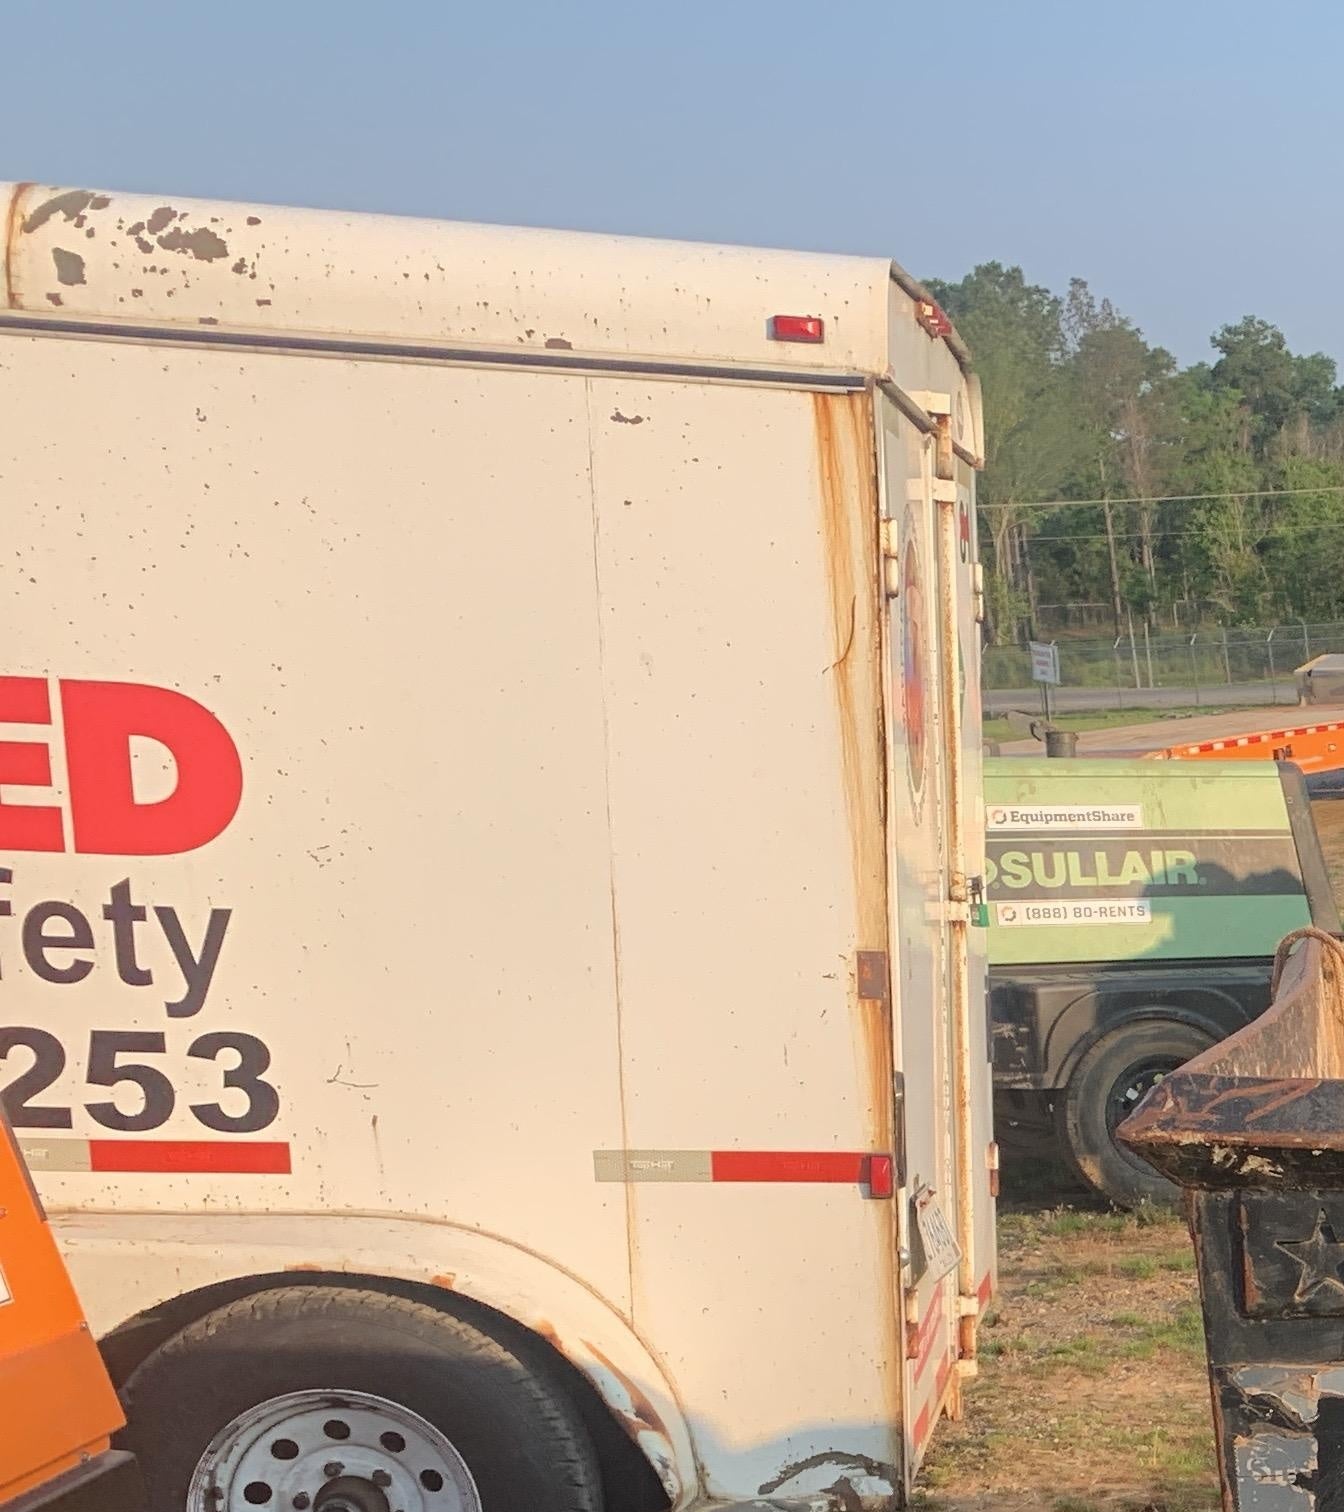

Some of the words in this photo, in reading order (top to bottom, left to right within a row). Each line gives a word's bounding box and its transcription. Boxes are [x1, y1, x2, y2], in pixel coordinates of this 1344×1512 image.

[1010, 810, 1135, 824] EquipmentShare
[1025, 906, 1068, 920] (888)
[1073, 904, 1146, 919] 80-RENTS
[0, 1027, 281, 1134] 253
